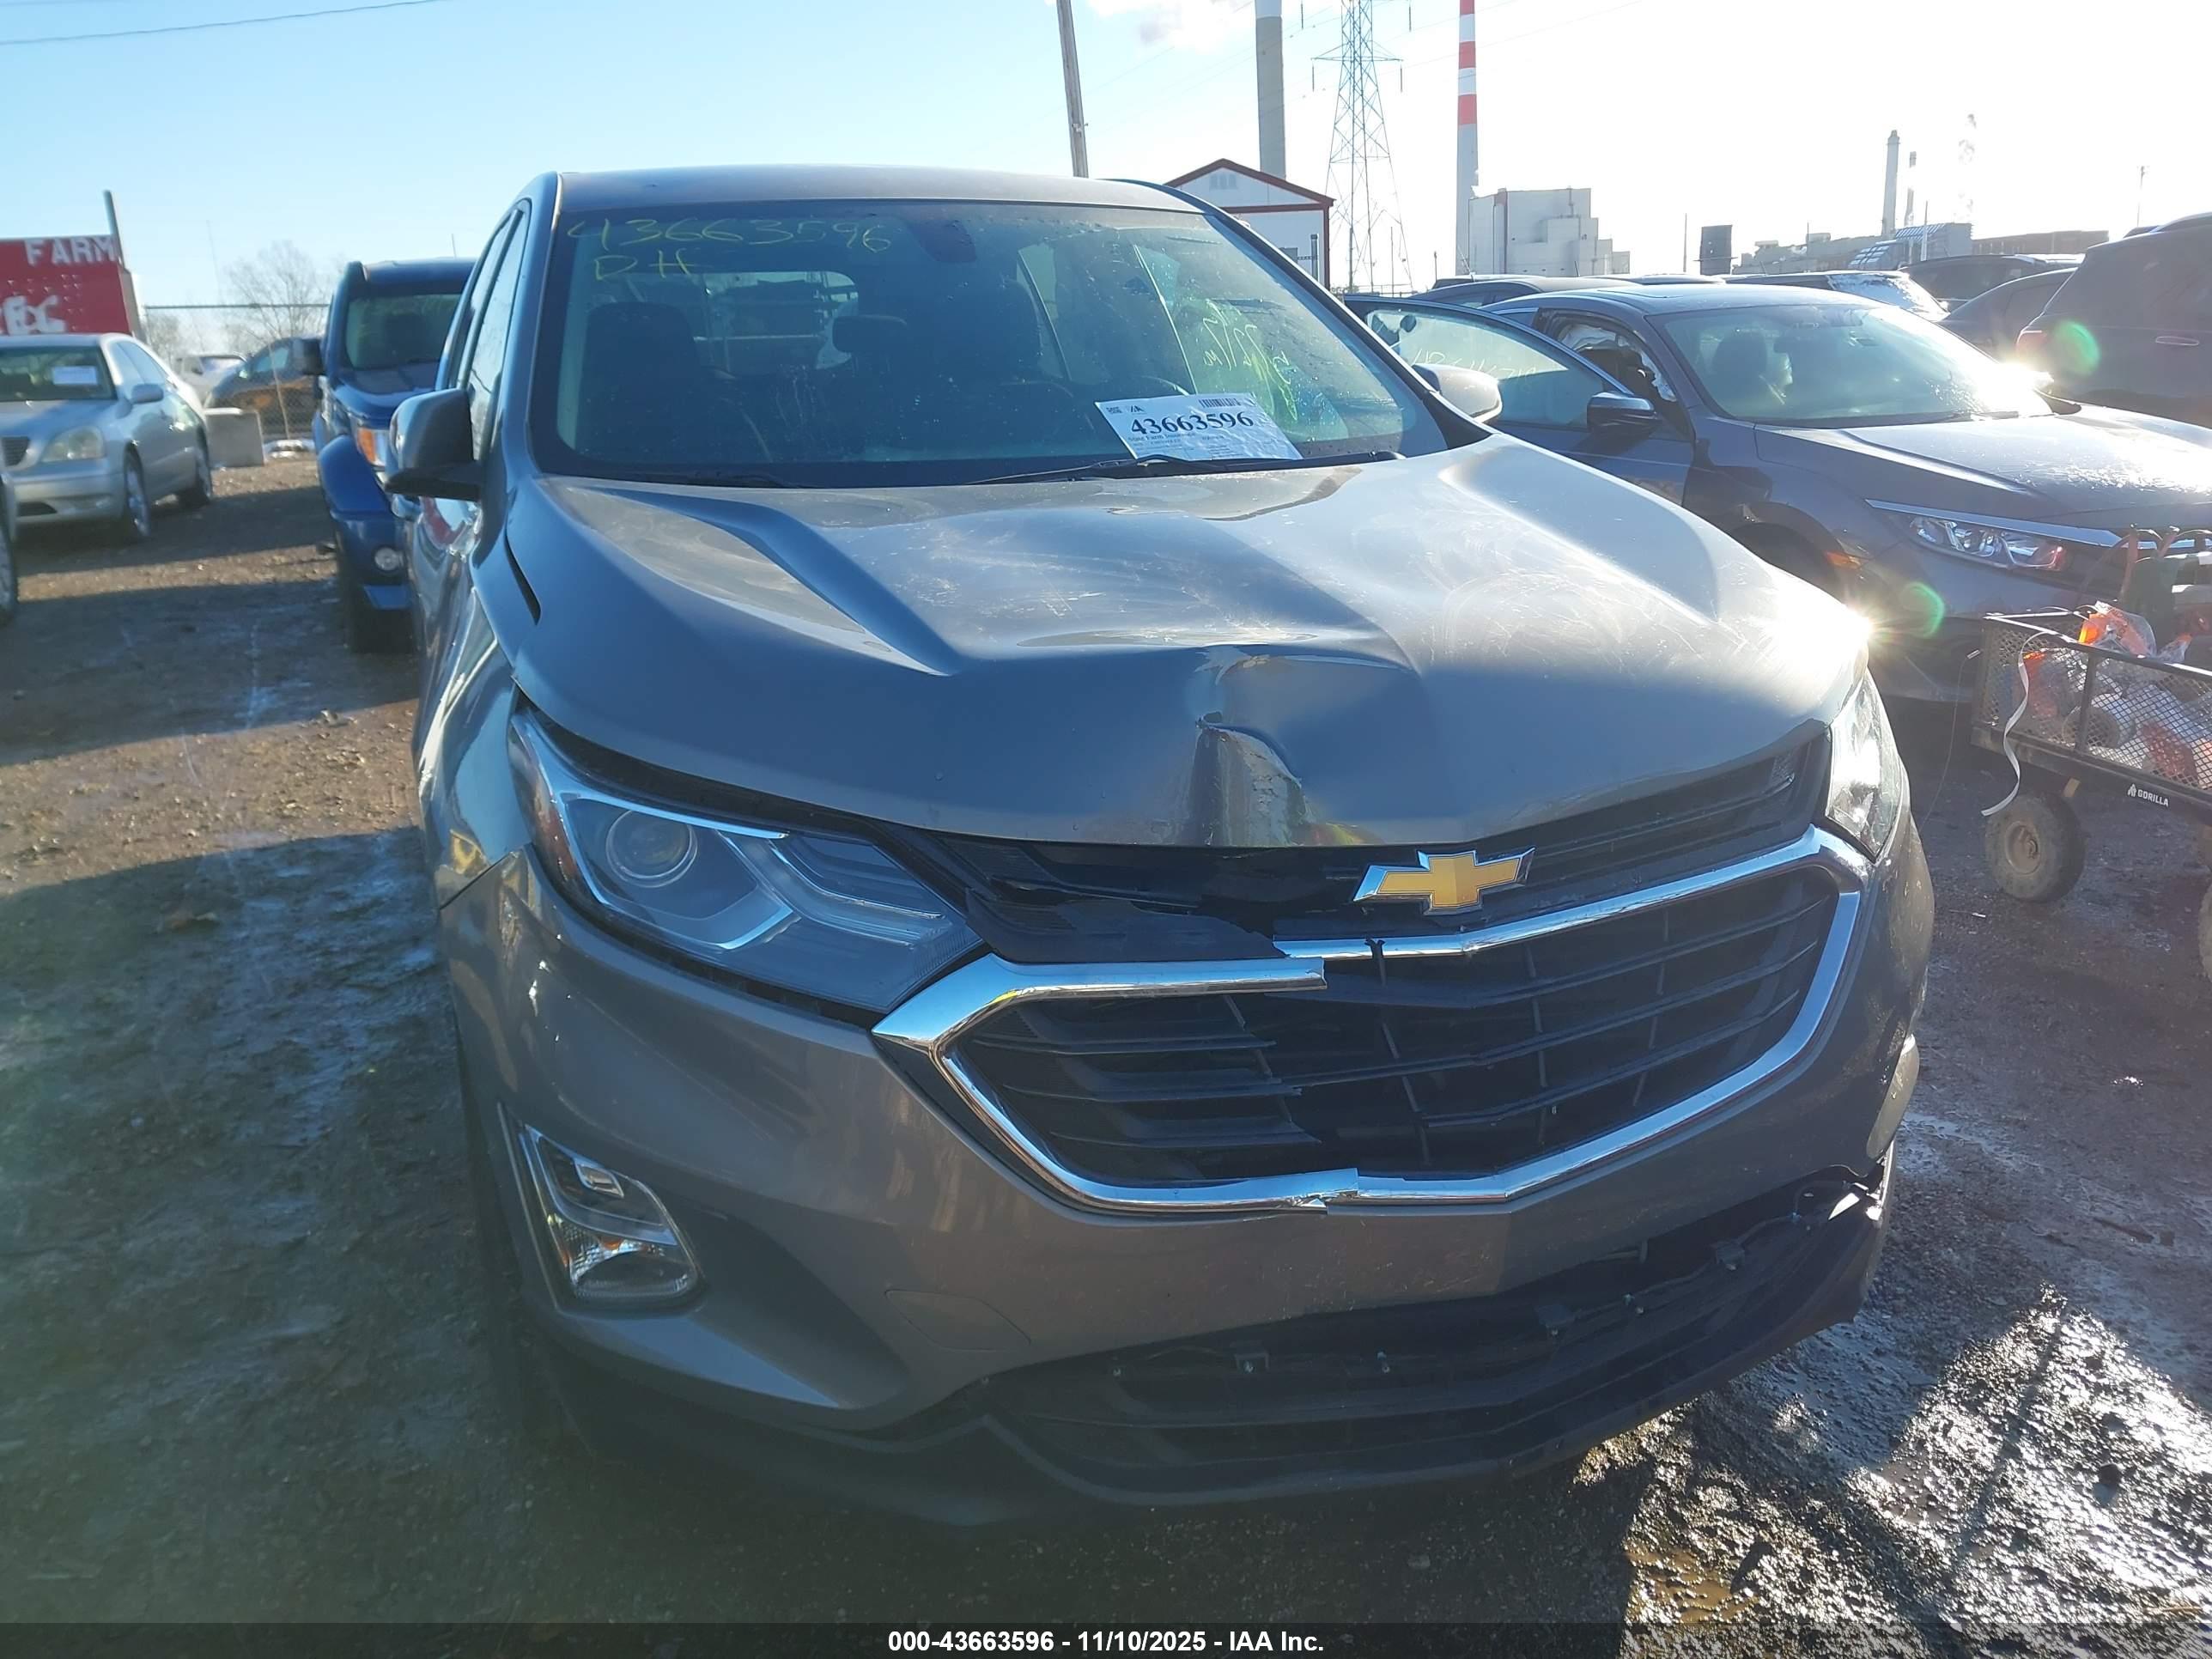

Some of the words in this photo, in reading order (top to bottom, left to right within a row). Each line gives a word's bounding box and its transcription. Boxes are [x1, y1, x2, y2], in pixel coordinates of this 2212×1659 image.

[567, 217, 892, 253] 43663596
[24, 237, 118, 267] FARM
[1131, 411, 1255, 435] 43663596
[2137, 788, 2169, 807] GORILLA
